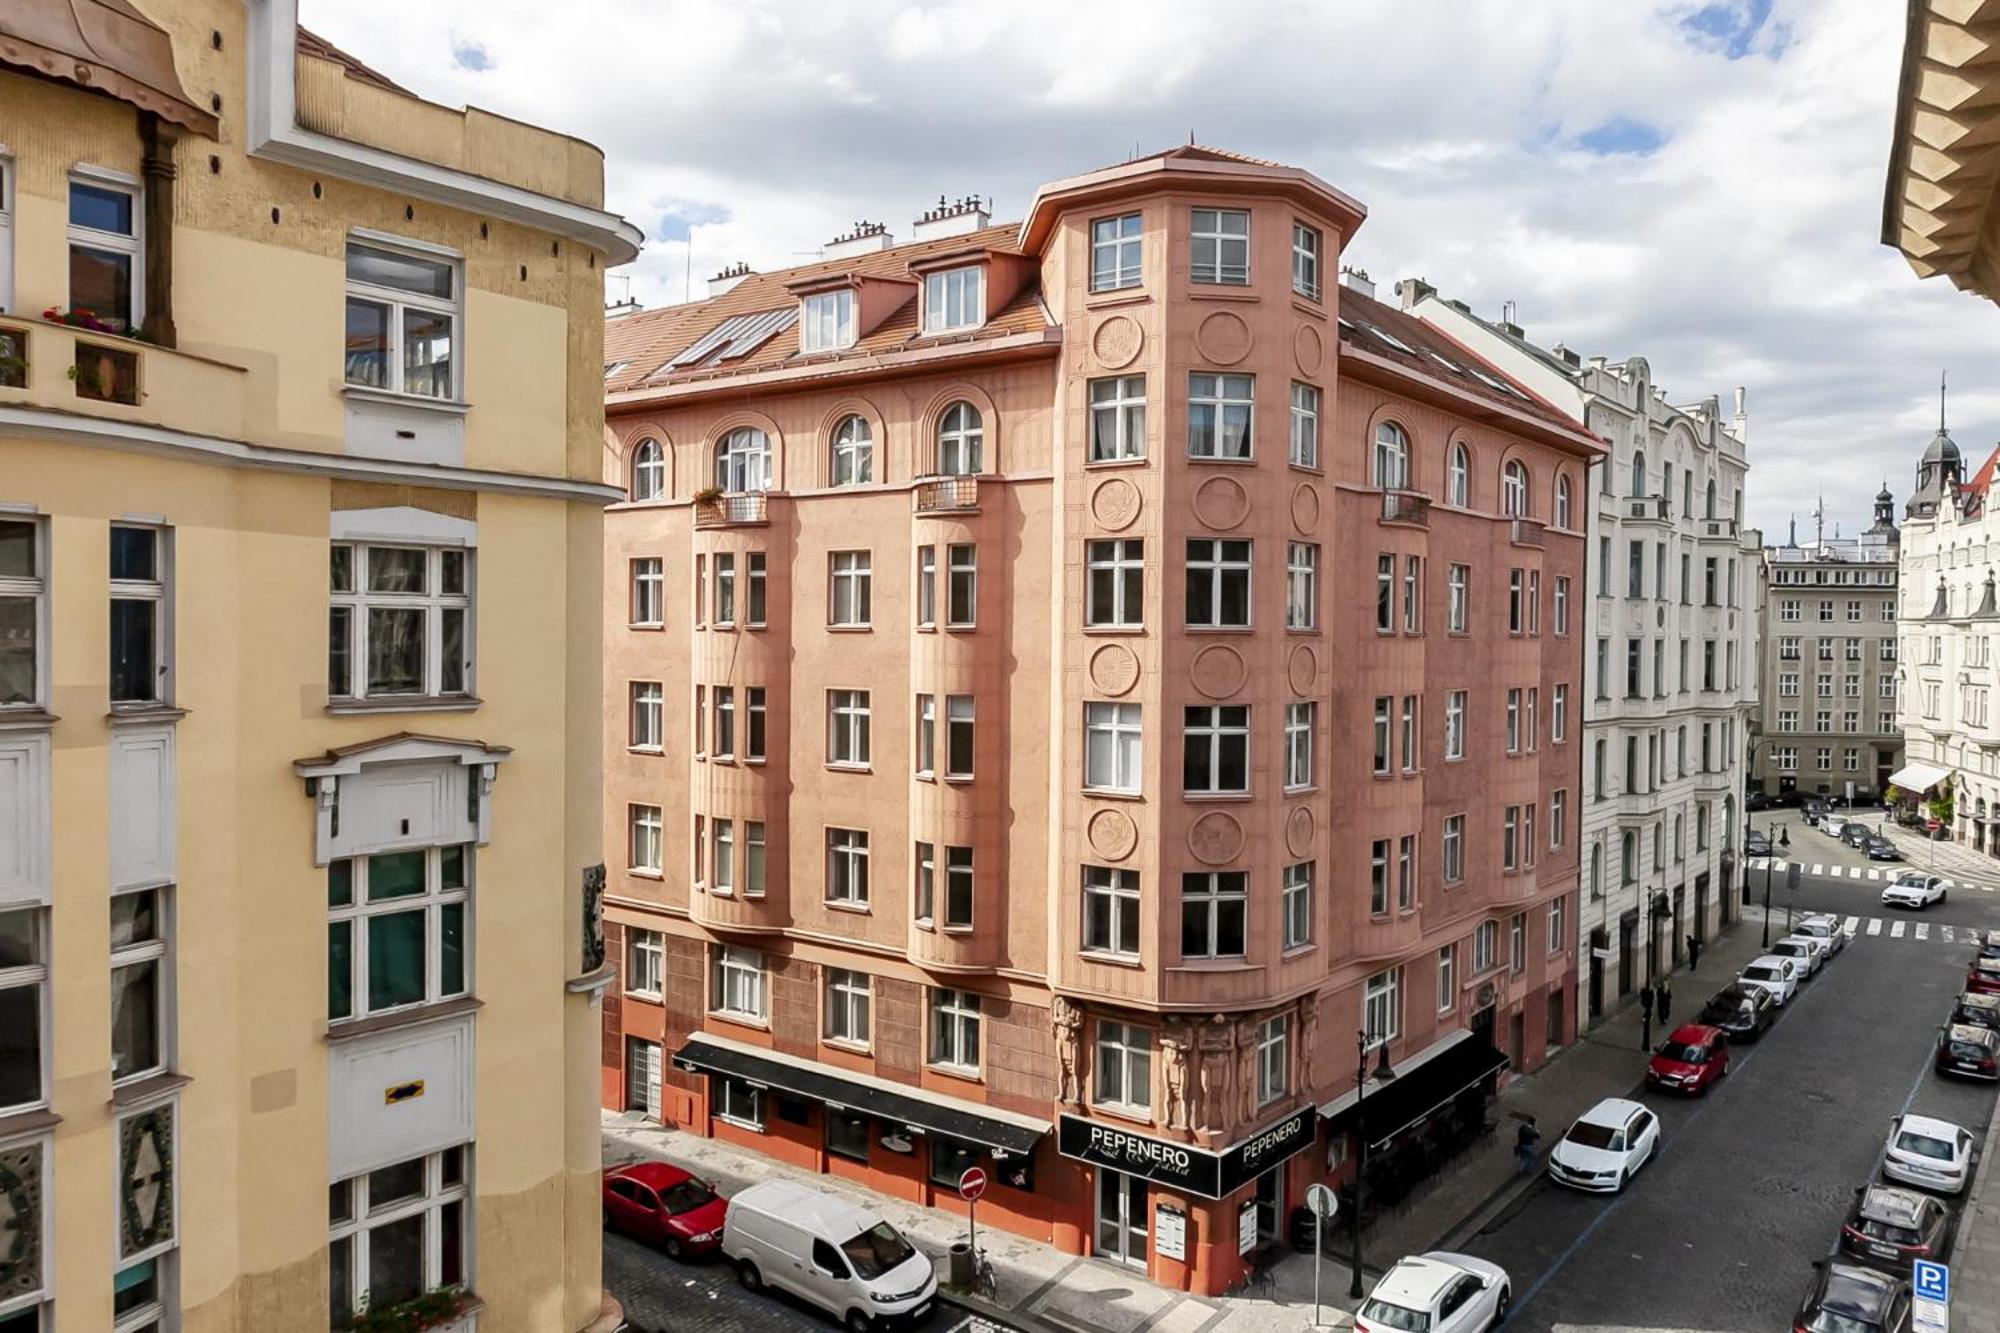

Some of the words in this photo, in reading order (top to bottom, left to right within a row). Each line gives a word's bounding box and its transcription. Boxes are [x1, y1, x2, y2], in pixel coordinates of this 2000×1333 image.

[1091, 1127, 1189, 1167] PEPENERO
[1243, 1117, 1301, 1162] PEPENERO
[1921, 1265, 1941, 1288] P
